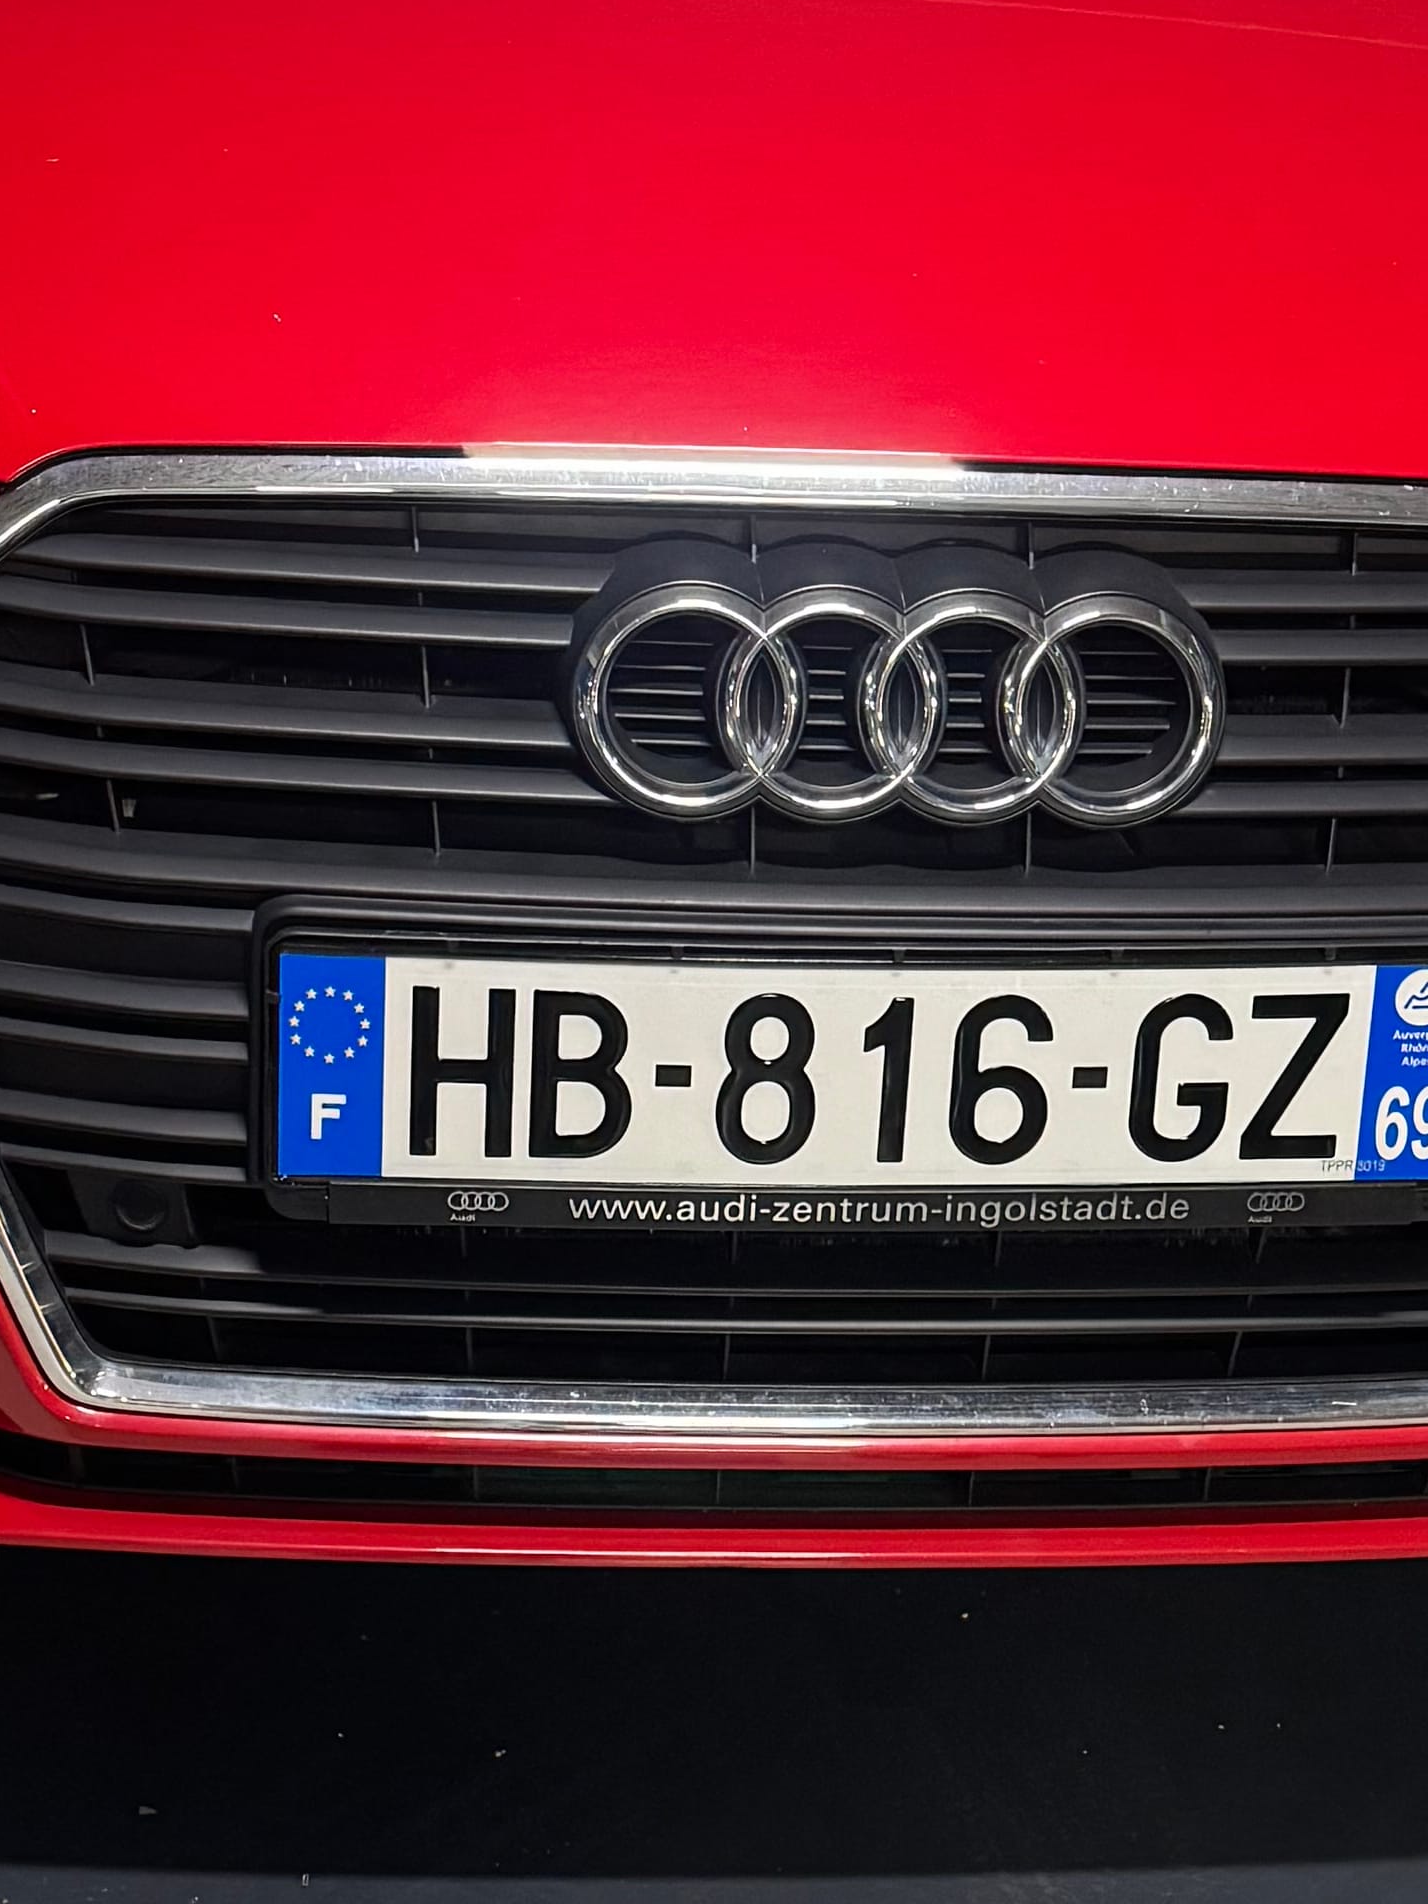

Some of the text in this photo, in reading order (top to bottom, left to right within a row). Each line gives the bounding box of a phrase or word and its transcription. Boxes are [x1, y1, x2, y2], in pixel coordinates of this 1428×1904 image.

[409, 985, 1350, 1162] HB-816-GZ
[310, 1093, 347, 1140] F
[450, 1213, 476, 1222] Audi
[568, 1192, 1190, 1227] www.audi-zentrum-ingolstadt.de
